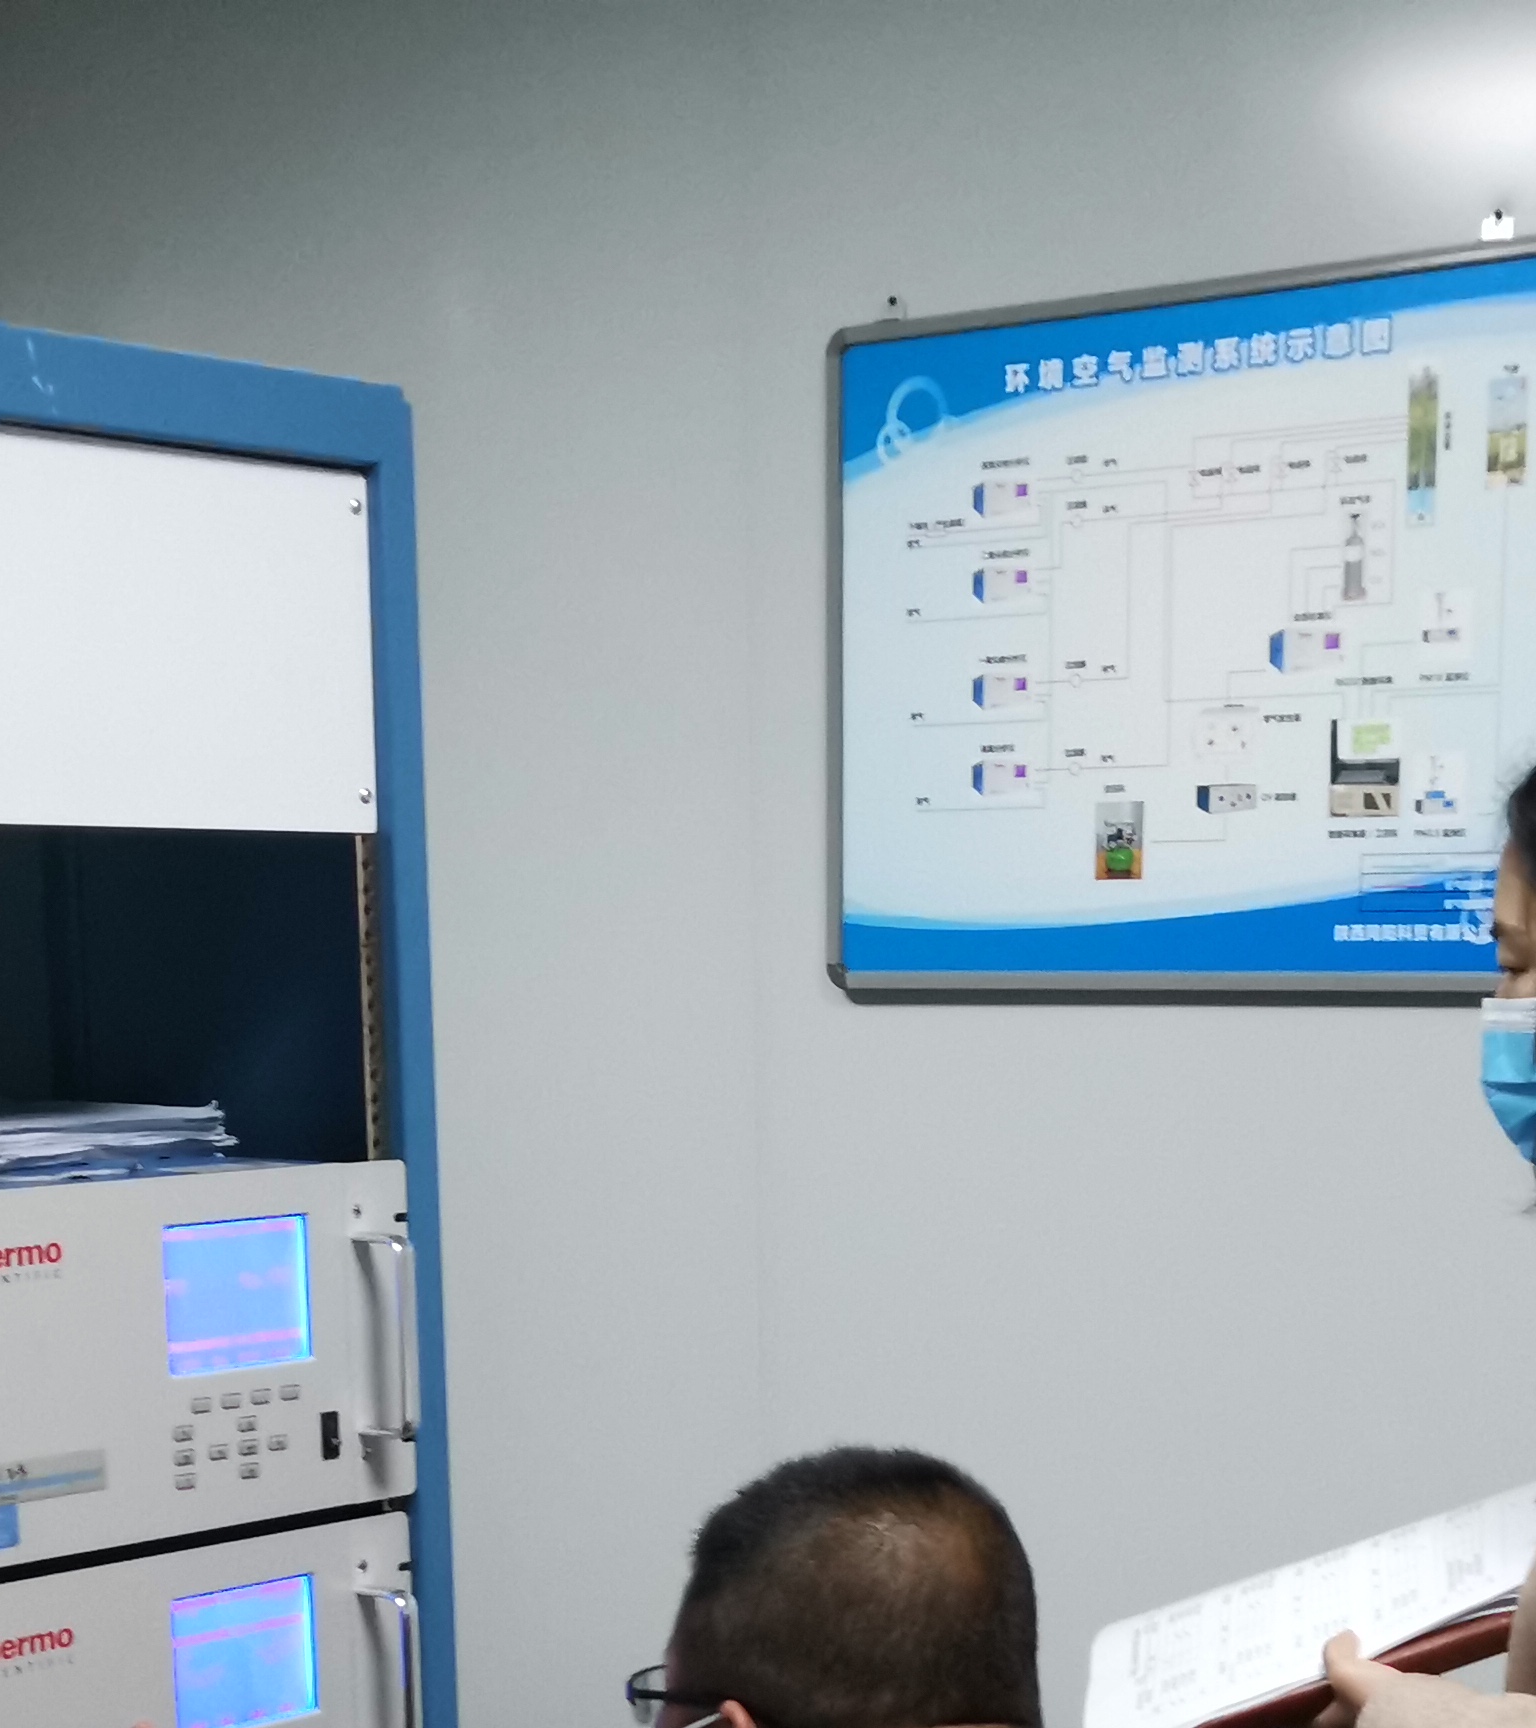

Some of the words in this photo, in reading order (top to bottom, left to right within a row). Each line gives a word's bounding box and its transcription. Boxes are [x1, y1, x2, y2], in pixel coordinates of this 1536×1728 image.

[1004, 316, 1392, 394] 环境空气监测系统示意图
